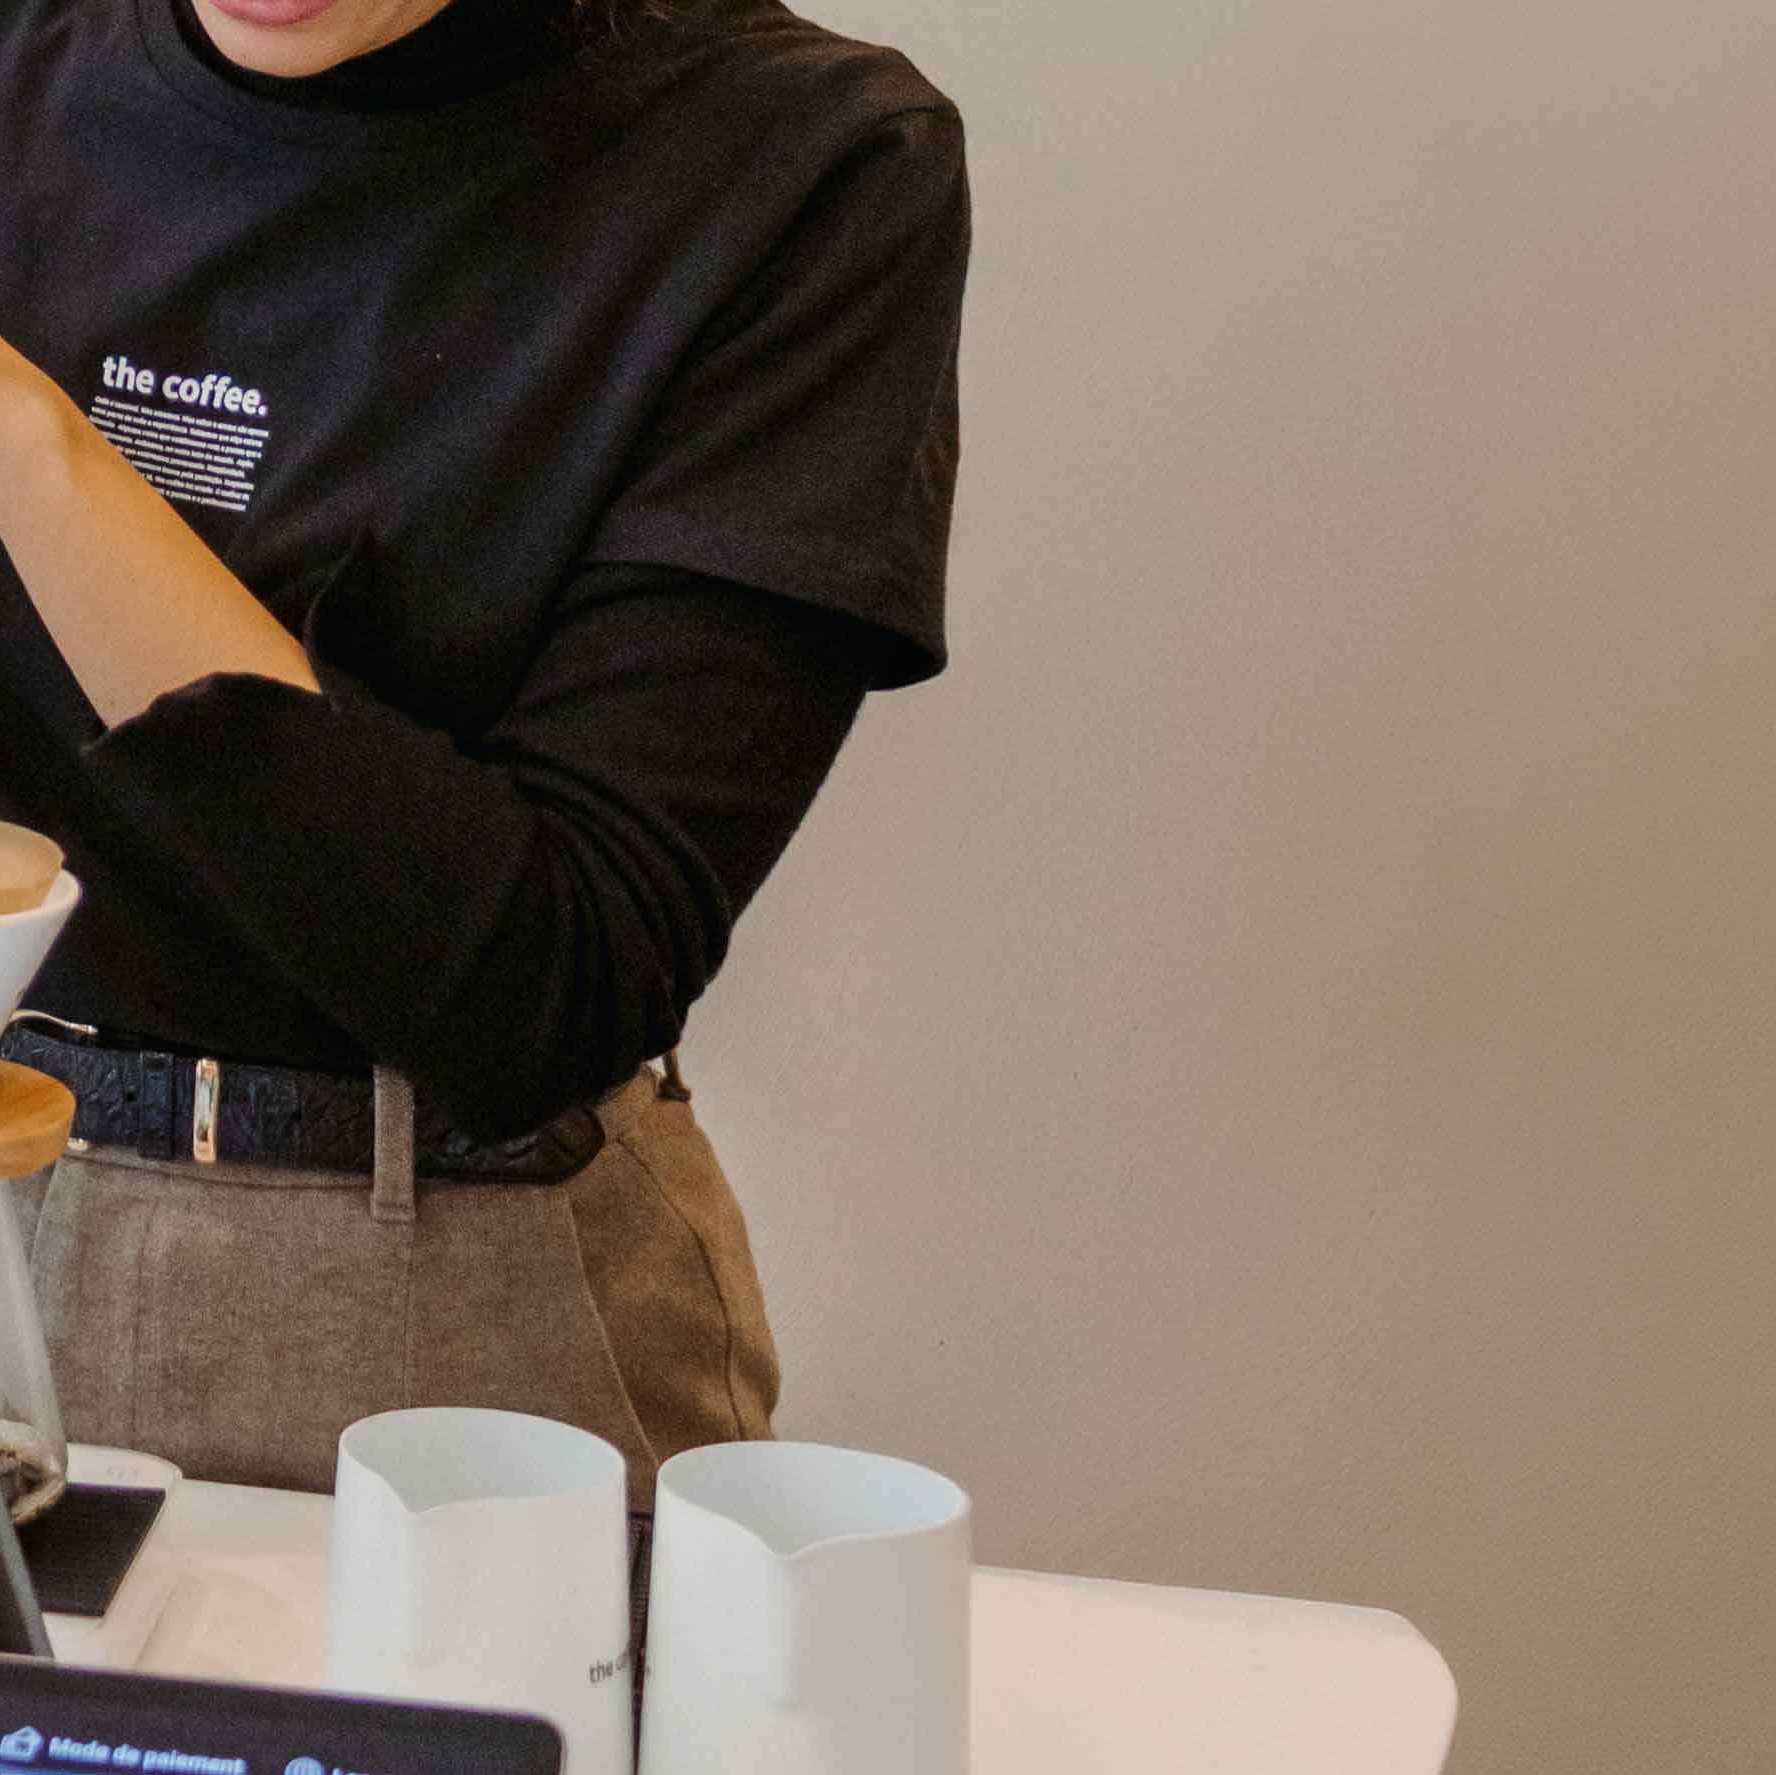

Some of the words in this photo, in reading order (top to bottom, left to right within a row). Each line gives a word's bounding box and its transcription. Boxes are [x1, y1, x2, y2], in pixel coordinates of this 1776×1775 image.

[102, 355, 155, 394] the
[161, 373, 269, 417] coffee.
[49, 1735, 111, 1765] Mode
[112, 1742, 141, 1769] de
[142, 1748, 248, 1775] paiement
